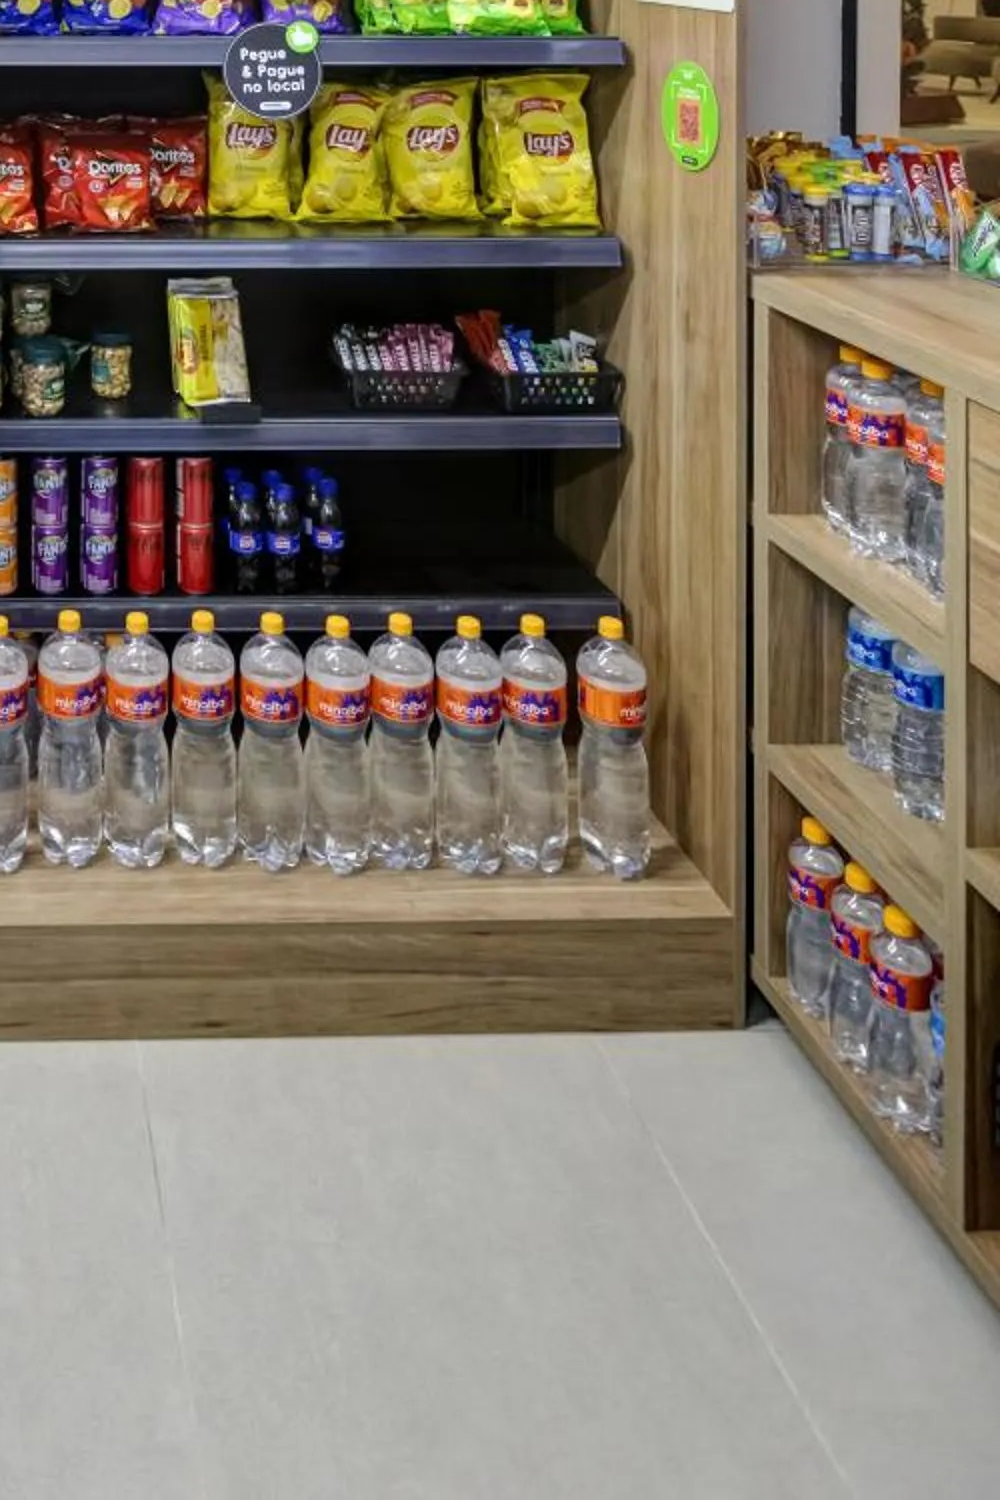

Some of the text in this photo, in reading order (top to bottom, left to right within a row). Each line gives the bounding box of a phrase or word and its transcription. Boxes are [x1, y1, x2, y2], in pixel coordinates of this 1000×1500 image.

[240, 47, 287, 63] Pegue
[242, 64, 305, 79] & Pague
[243, 78, 305, 94] no local
[228, 123, 277, 149] Lay's
[410, 125, 457, 151] Lay's
[526, 132, 571, 158] Lay's
[88, 159, 142, 176] Doritos
